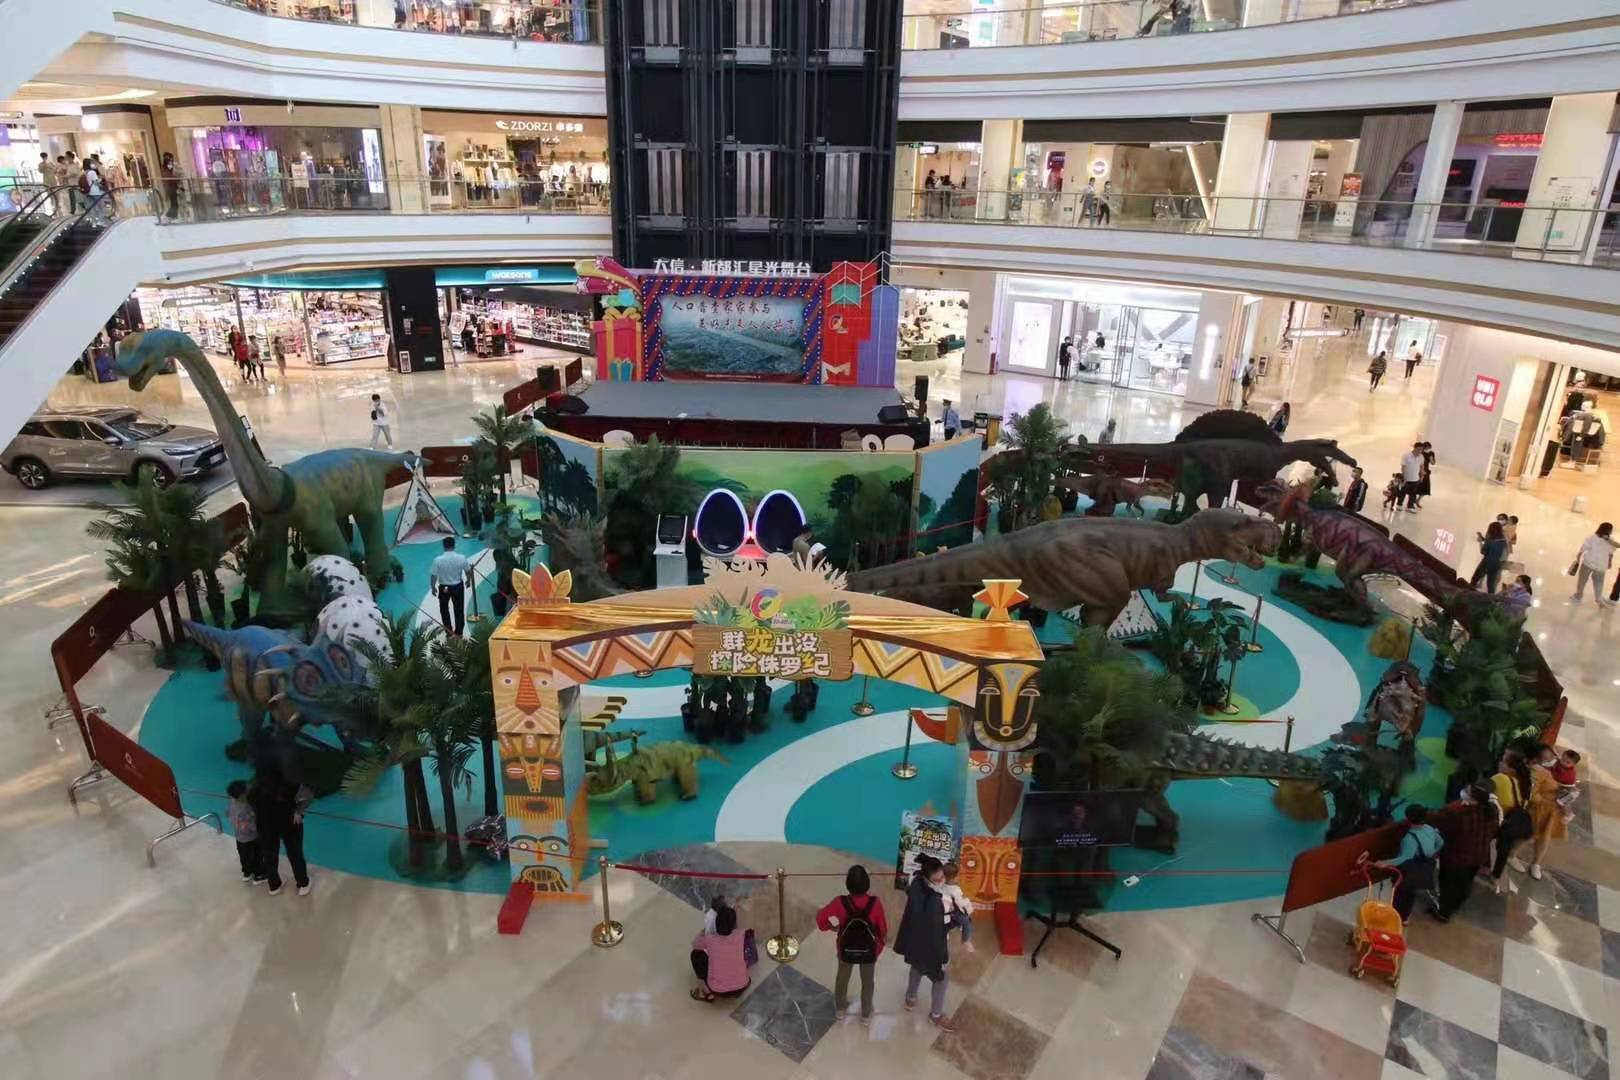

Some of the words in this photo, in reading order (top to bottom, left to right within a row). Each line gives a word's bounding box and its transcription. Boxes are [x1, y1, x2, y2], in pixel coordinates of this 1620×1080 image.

[511, 120, 553, 132] ZDORZI
[720, 628, 818, 655] 群龙出没
[710, 649, 832, 676] 探险侏罗纪
